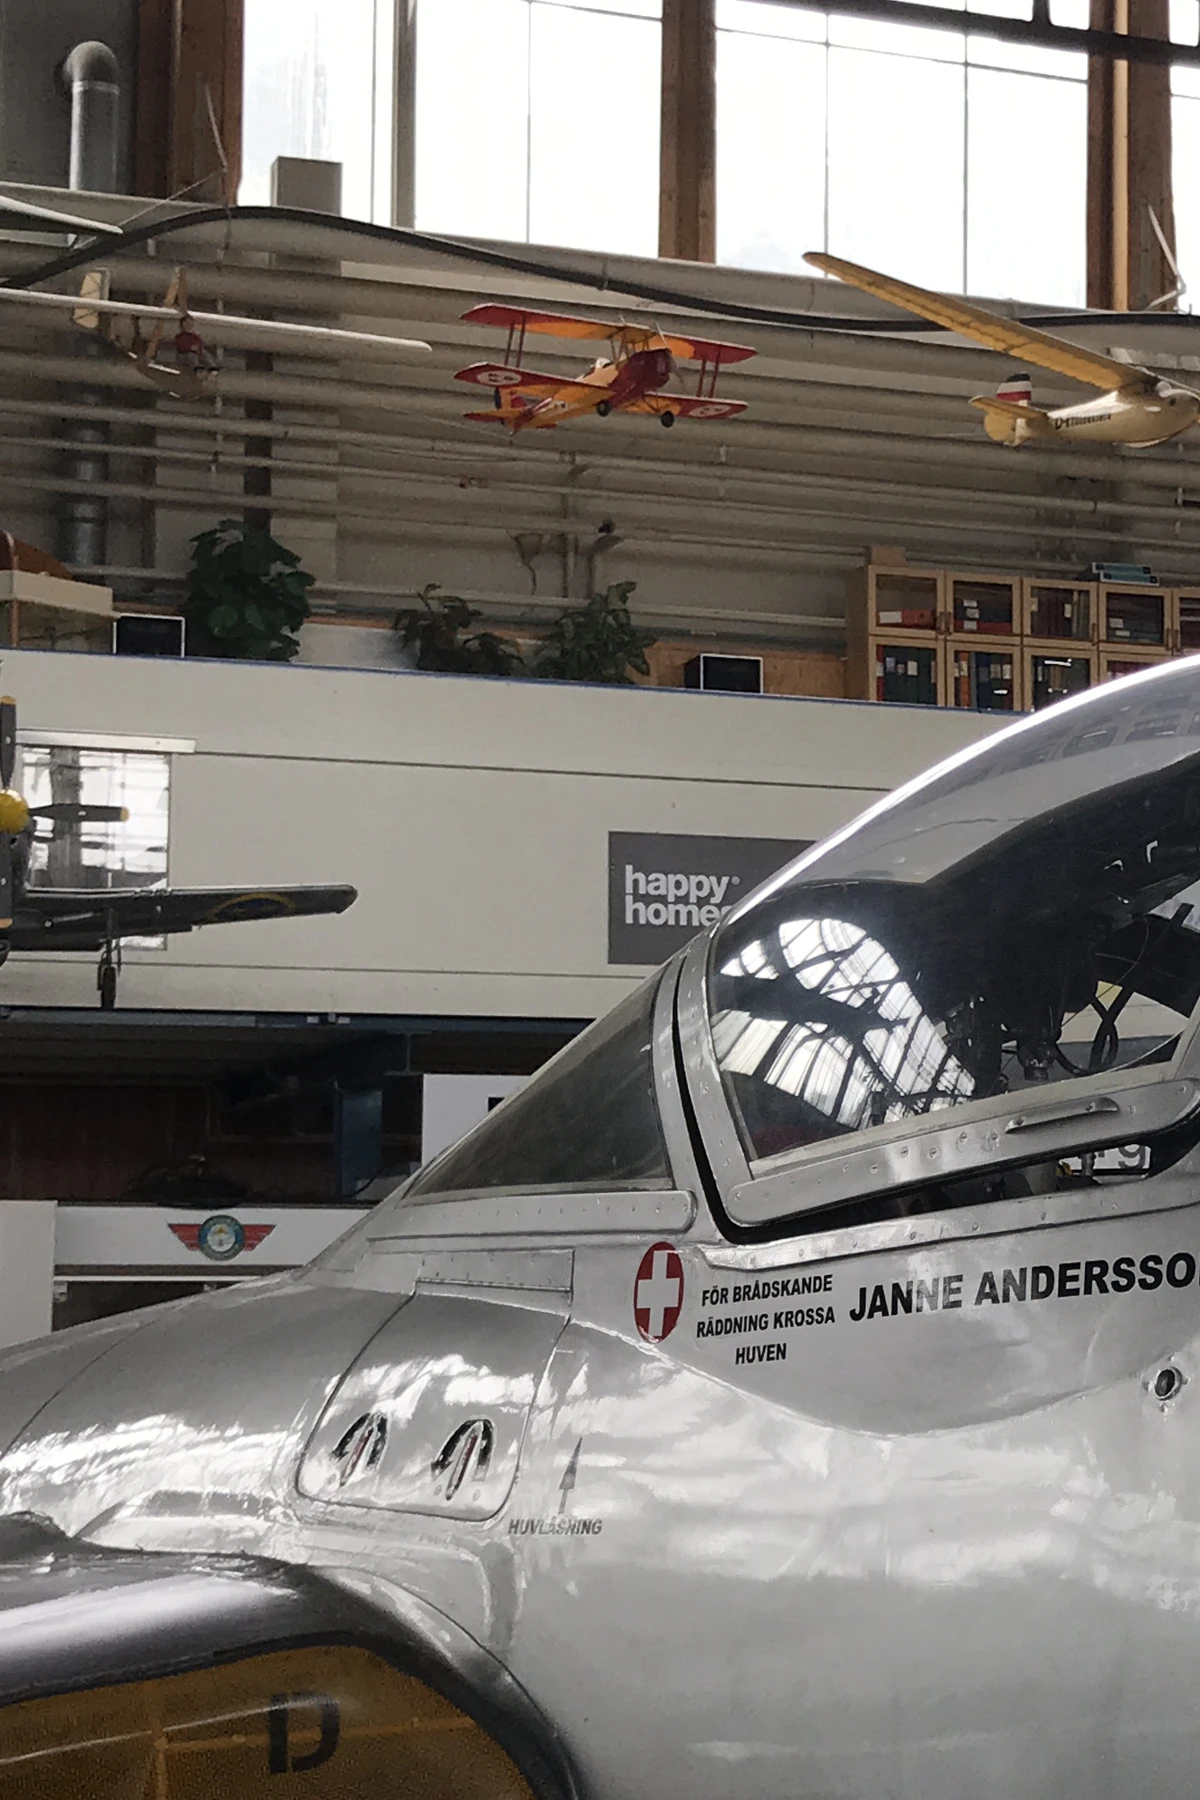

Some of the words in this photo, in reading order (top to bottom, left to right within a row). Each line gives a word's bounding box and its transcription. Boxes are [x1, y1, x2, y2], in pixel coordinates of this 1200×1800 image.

[625, 864, 729, 904] happy
[701, 1286, 728, 1306] FÖR
[733, 1274, 833, 1303] BRÅDSKANDE
[849, 1274, 964, 1322] JANNE
[696, 1312, 769, 1338] RÄDDNING
[773, 1306, 836, 1329] KROSSA
[735, 1342, 787, 1365] HUVEN
[268, 1690, 340, 1775] D
